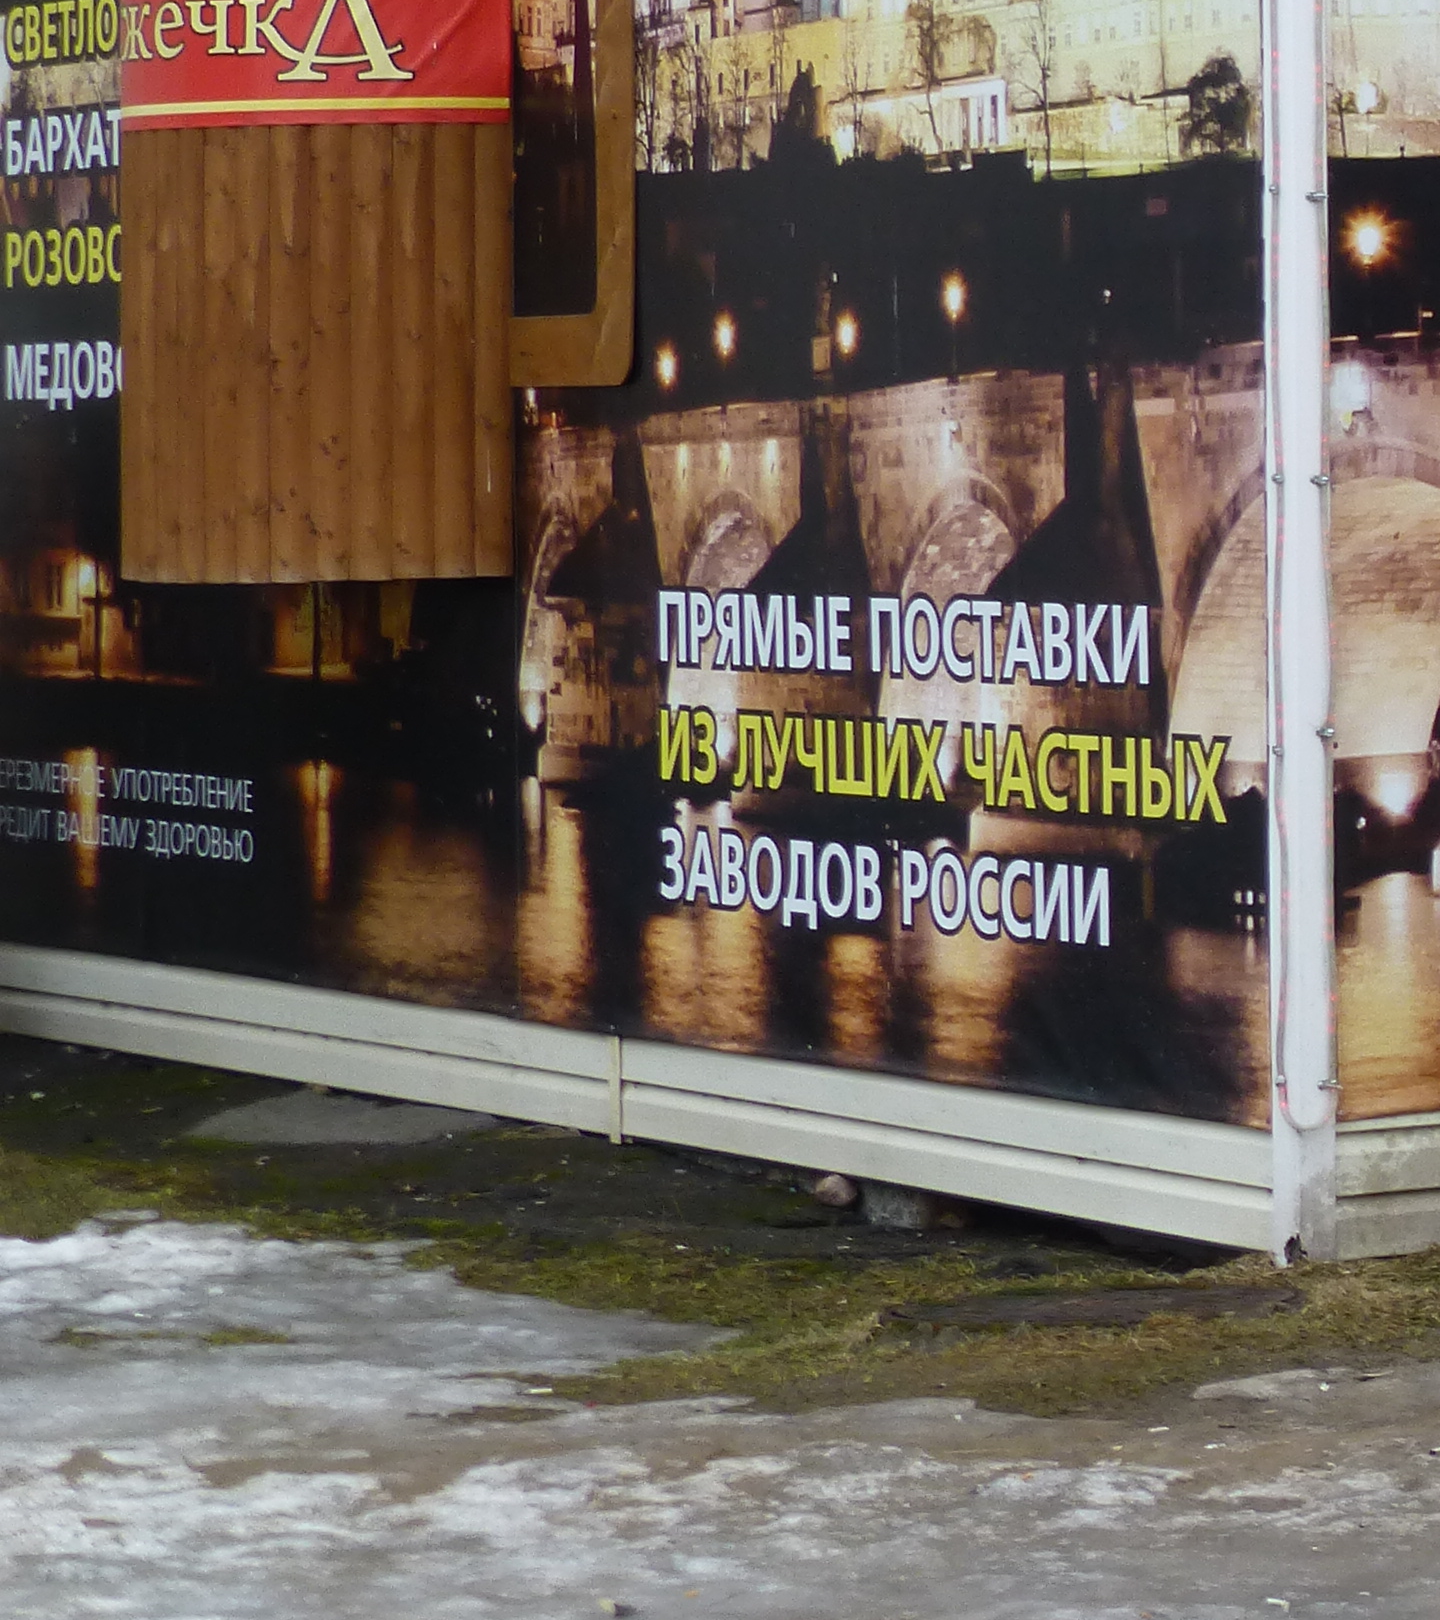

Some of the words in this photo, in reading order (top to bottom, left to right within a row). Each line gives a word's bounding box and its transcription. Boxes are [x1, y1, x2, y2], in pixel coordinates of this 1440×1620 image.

[6, 107, 121, 176] БАРХАТ
[6, 341, 122, 411] МЕДОВ
[658, 591, 852, 671] ПРЯМЫЕ
[869, 598, 1149, 685] ПОСТАВКИ
[112, 768, 254, 813] УПОТРЕБЛЕНИЕ
[659, 710, 718, 784] ИЗ
[733, 715, 946, 802] ЛУЧШИХ
[963, 728, 1227, 823] ЧАСТНЫХ
[57, 811, 140, 850] ВАШЕМУ
[146, 819, 254, 863] ЗДОРОВЬЮ
[659, 829, 882, 930] ЗАВОДОВ
[902, 850, 1110, 947] РОССИИ
